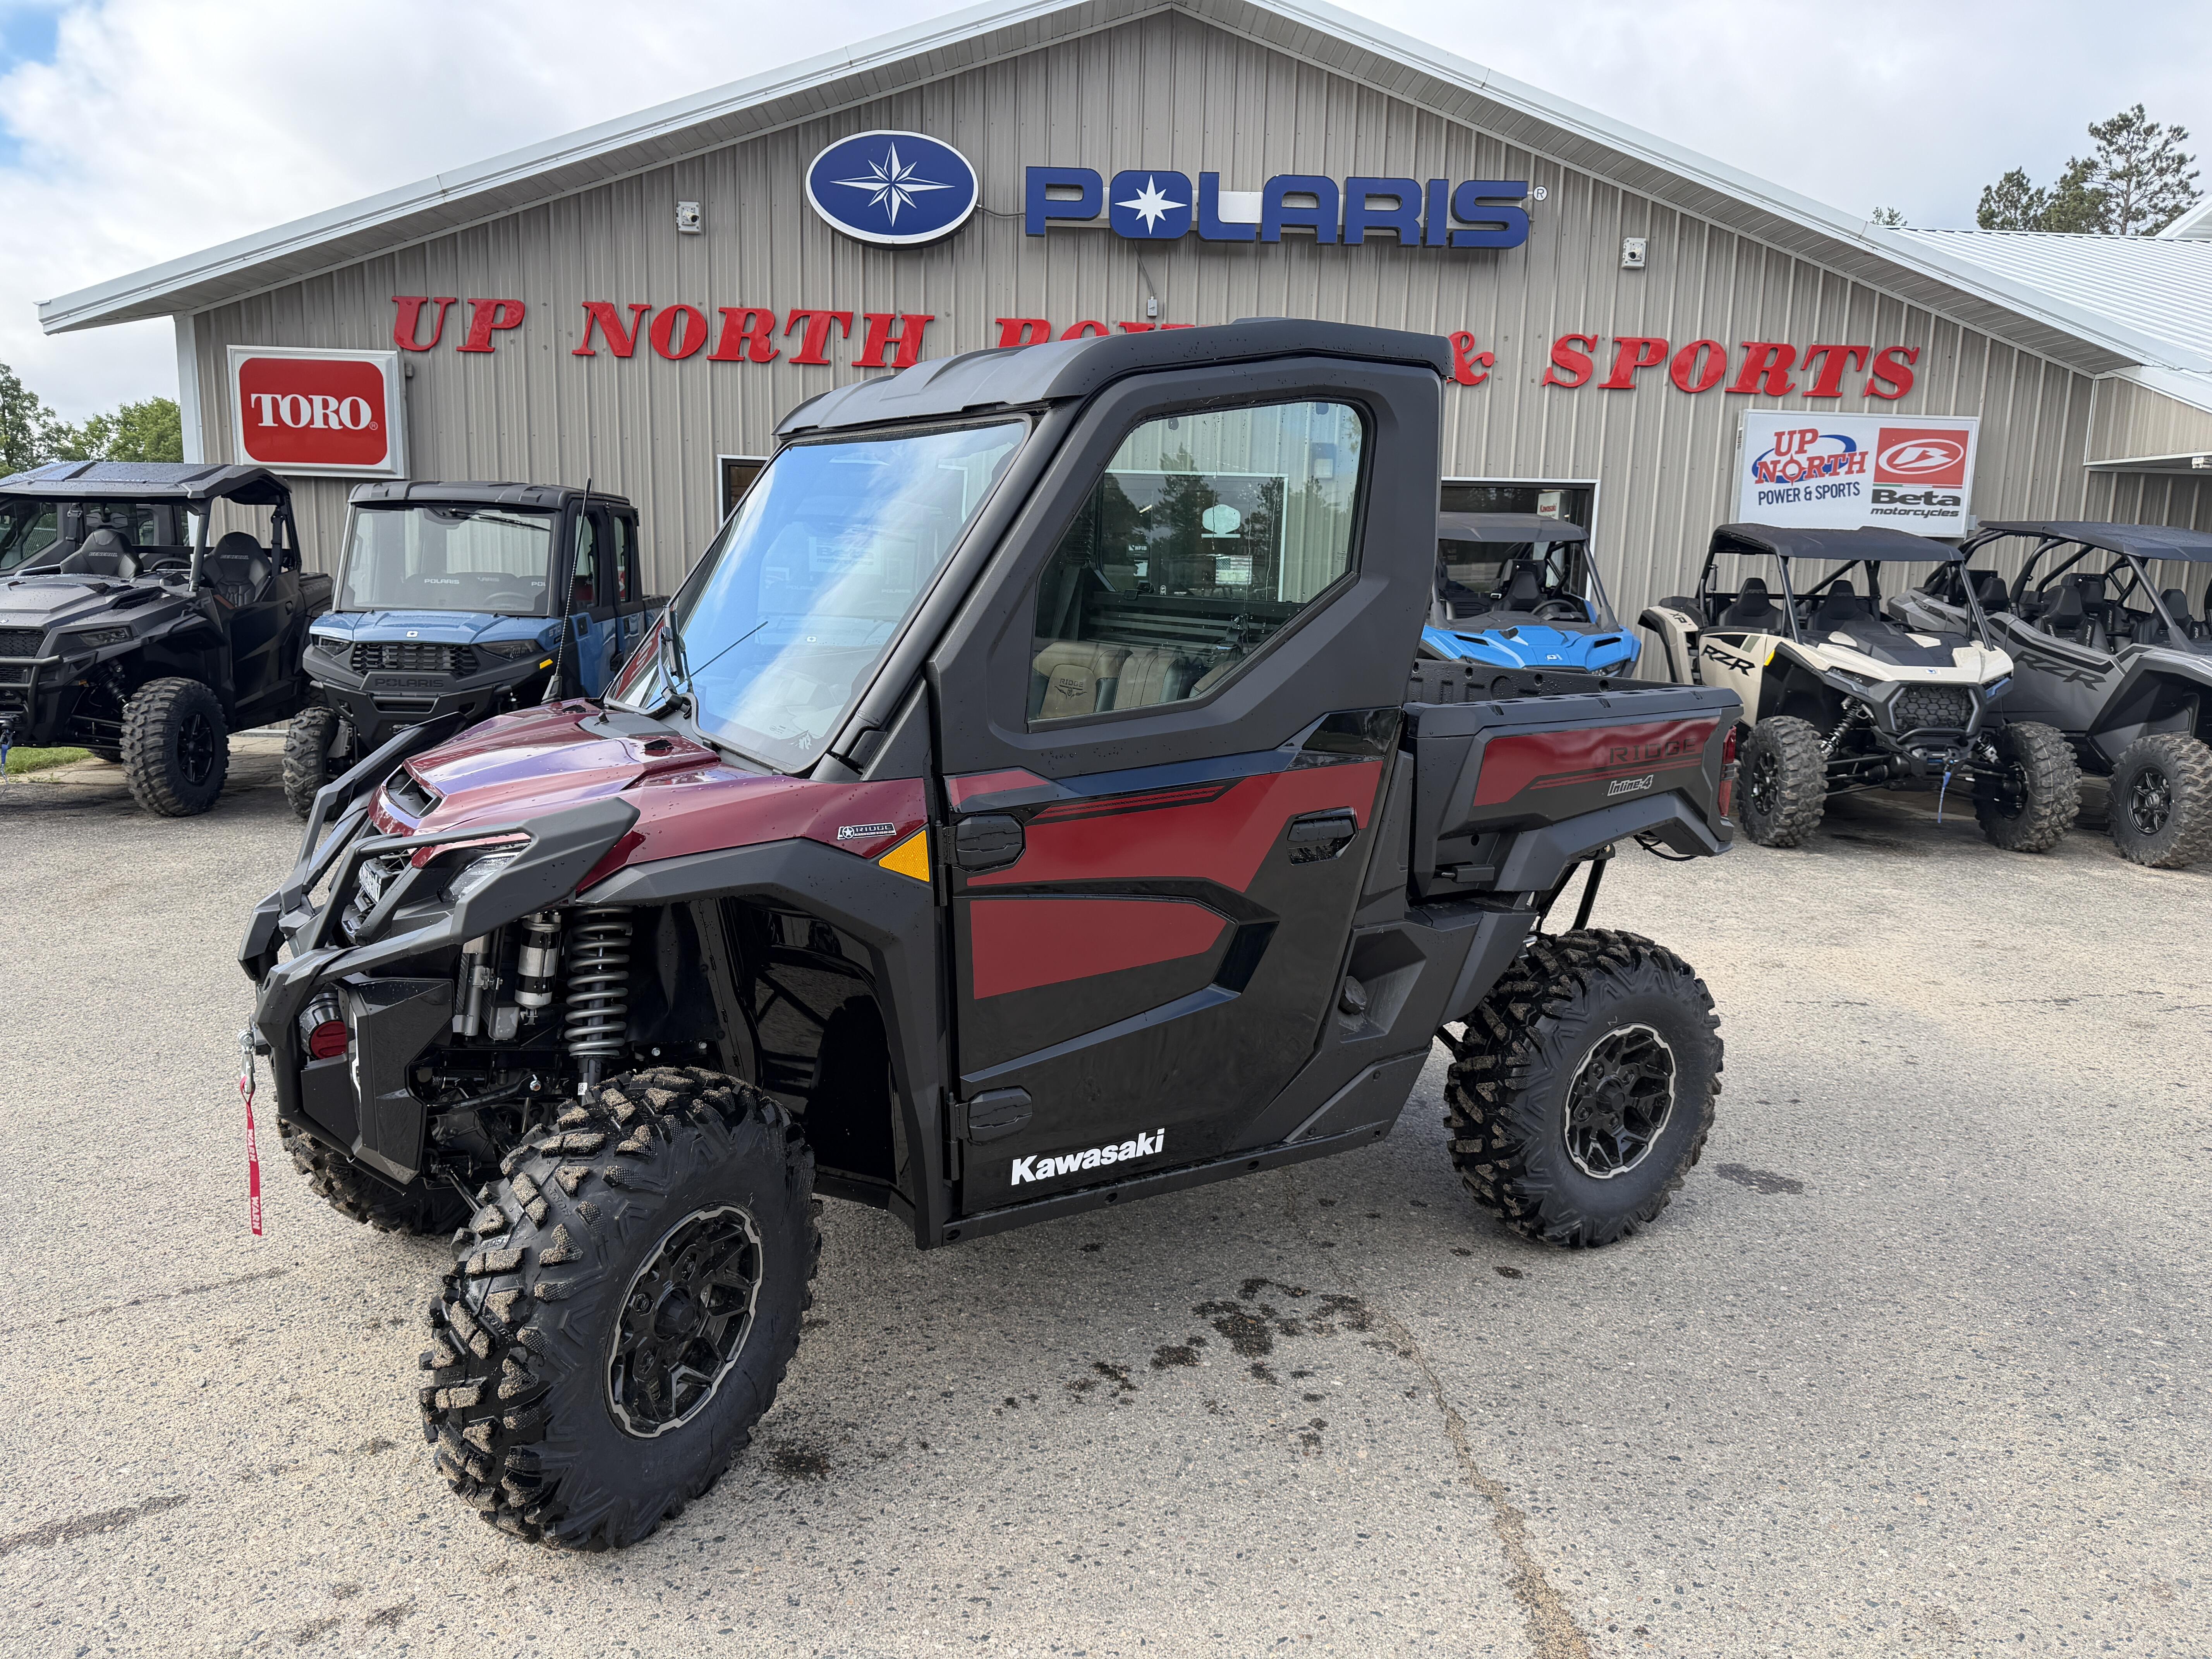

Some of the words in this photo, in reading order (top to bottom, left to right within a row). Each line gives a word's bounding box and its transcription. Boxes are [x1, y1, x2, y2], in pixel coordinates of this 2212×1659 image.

[1025, 166, 1530, 250] POLARIS
[392, 296, 526, 352] UP
[571, 301, 935, 368] NORTH
[1447, 330, 1495, 386] &
[1542, 333, 1920, 400] SPORTS
[251, 393, 372, 430] TORO
[1774, 428, 1819, 457] UP
[1754, 451, 1869, 486] NORTH
[1758, 485, 1800, 505] POWER
[1804, 486, 1812, 500] &
[1815, 482, 1860, 499] SPORTS
[1871, 489, 1961, 507] Beta
[1870, 507, 1959, 519] motorcycles
[186, 597, 212, 612] XP
[1669, 613, 1688, 623] XP
[1700, 644, 1755, 677] RZR
[2013, 651, 2107, 692] RZR
[374, 678, 444, 688] POLARIS
[1060, 678, 1084, 687] RIDGE
[1610, 738, 1697, 763] RIDGE
[247, 1128, 257, 1162] WARN
[1011, 1128, 1165, 1186] Kawasaki
[251, 1196, 261, 1230] WARN
